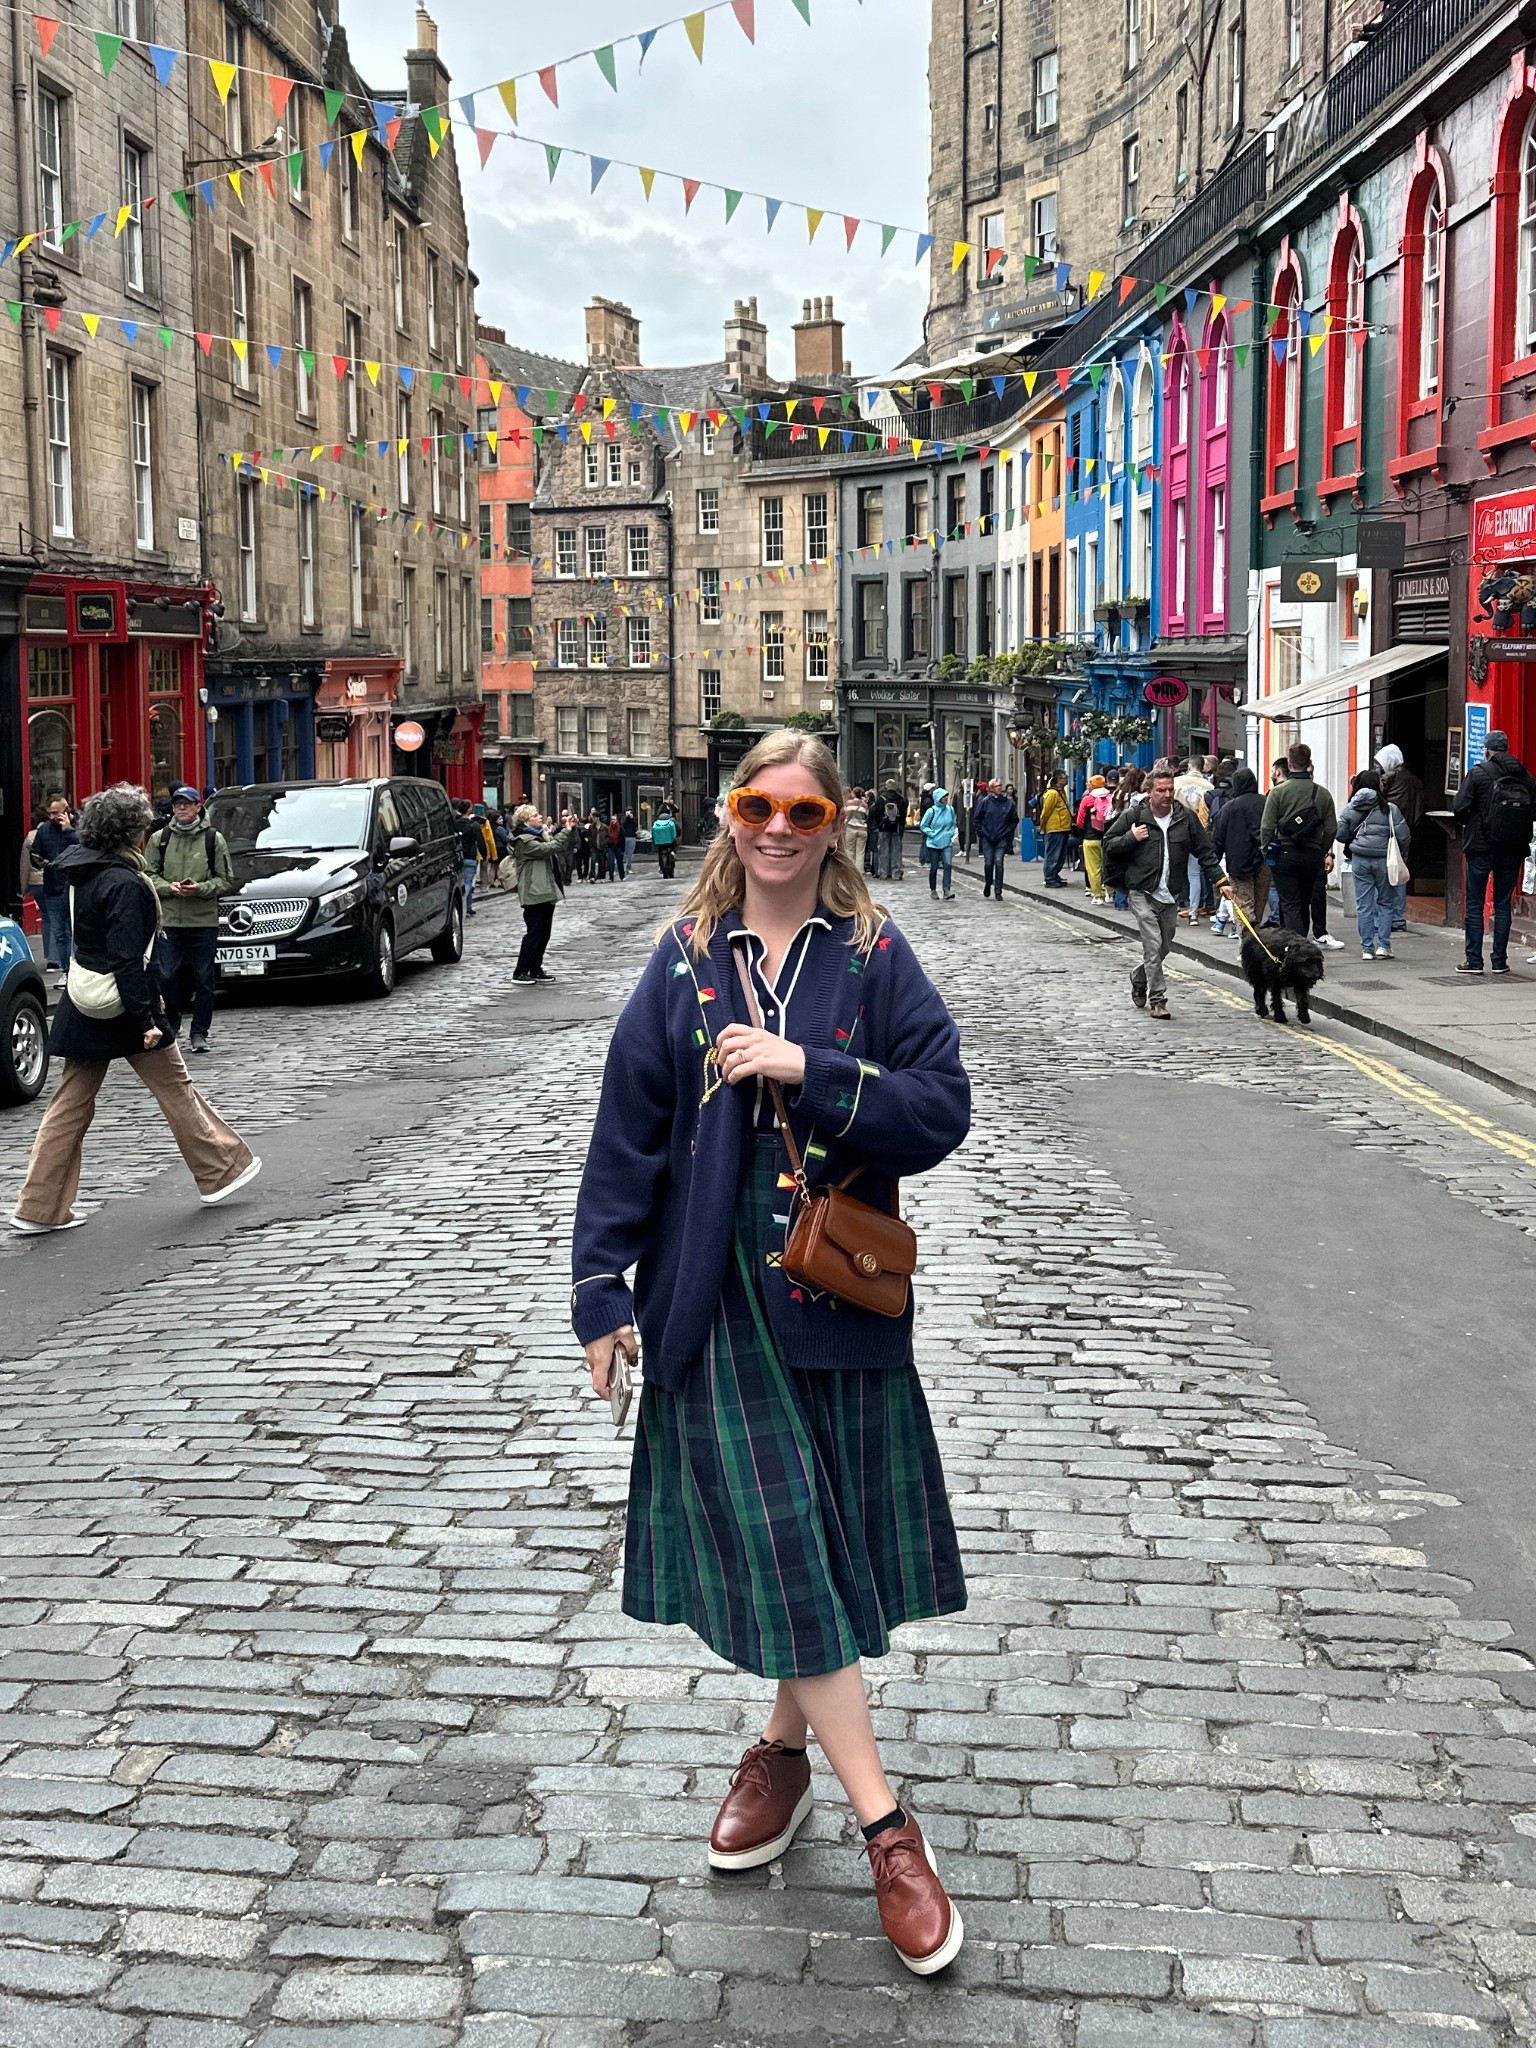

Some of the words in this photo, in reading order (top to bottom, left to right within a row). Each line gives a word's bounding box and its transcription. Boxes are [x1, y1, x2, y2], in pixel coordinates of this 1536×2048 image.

[1478, 506, 1497, 542] The
[1495, 504, 1535, 536] ELEPHANT
[1430, 578, 1436, 595] &
[870, 690, 896, 700] Walker
[899, 690, 920, 701] Slater
[1152, 681, 1183, 700] PINK
[246, 946, 270, 960] SYA
